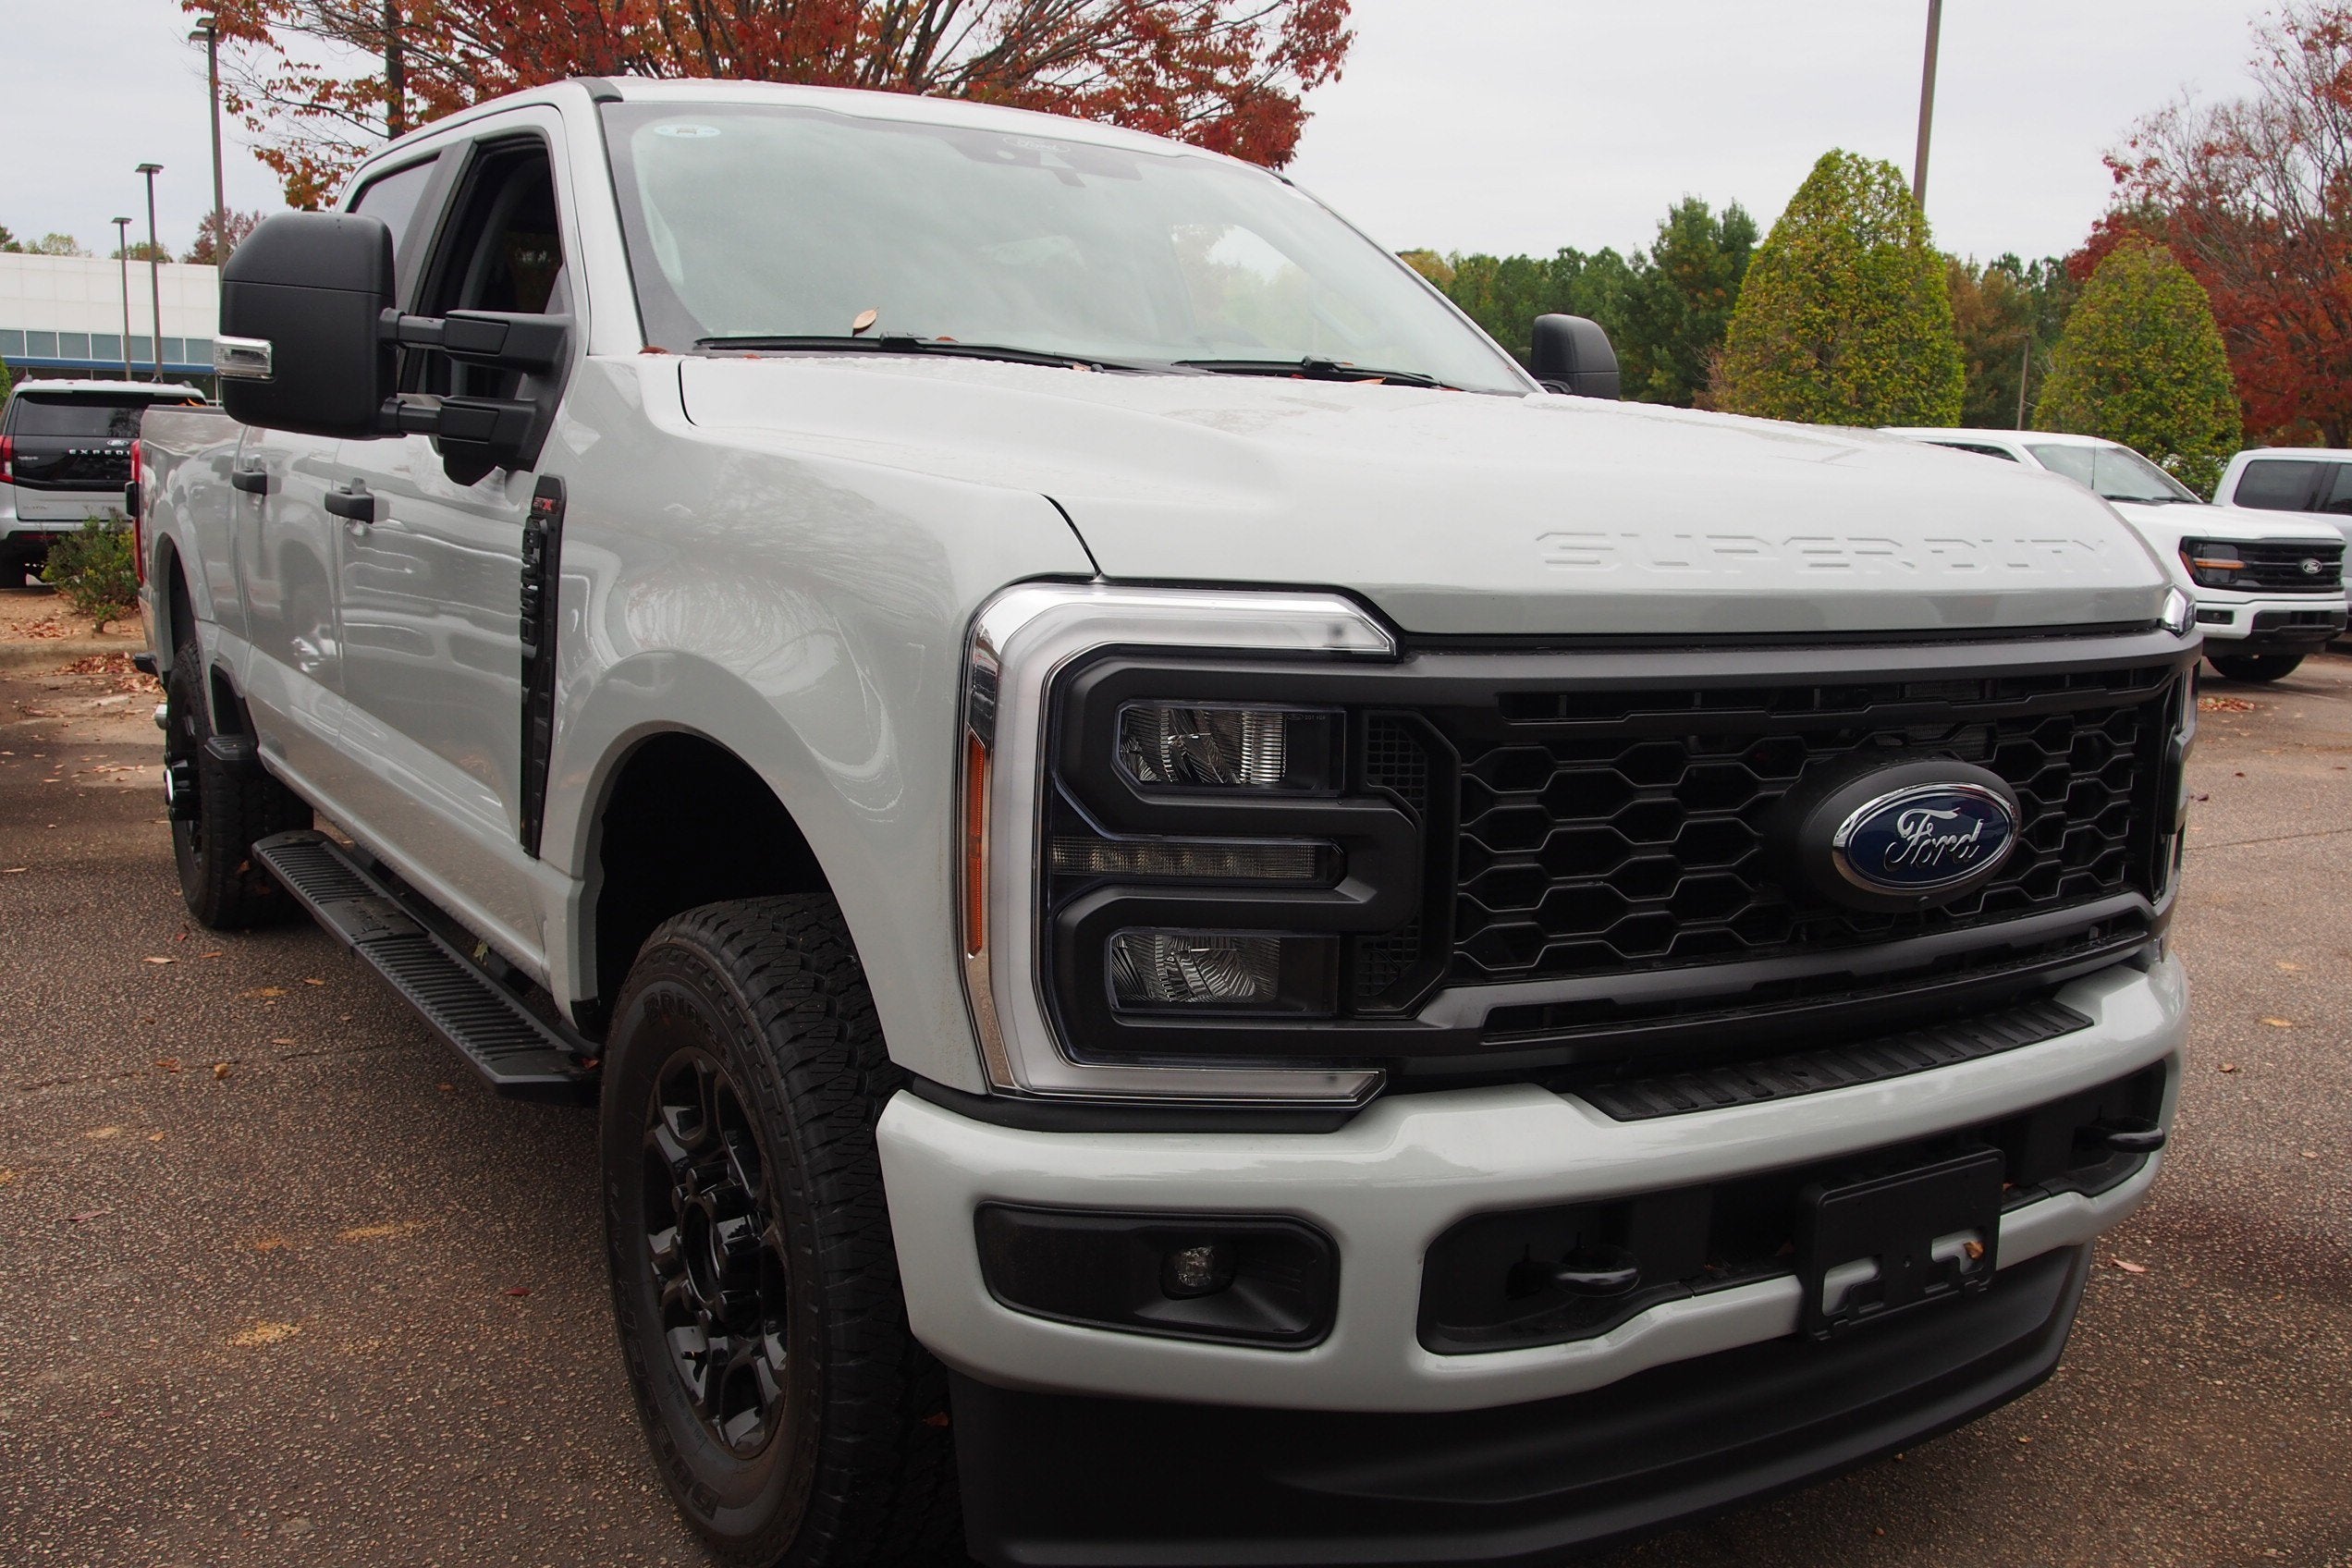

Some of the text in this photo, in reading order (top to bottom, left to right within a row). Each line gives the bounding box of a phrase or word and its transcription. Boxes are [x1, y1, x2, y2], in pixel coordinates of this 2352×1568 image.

[1535, 532, 2114, 574] SUPER DUTY
[1884, 807, 1985, 872] Ford
